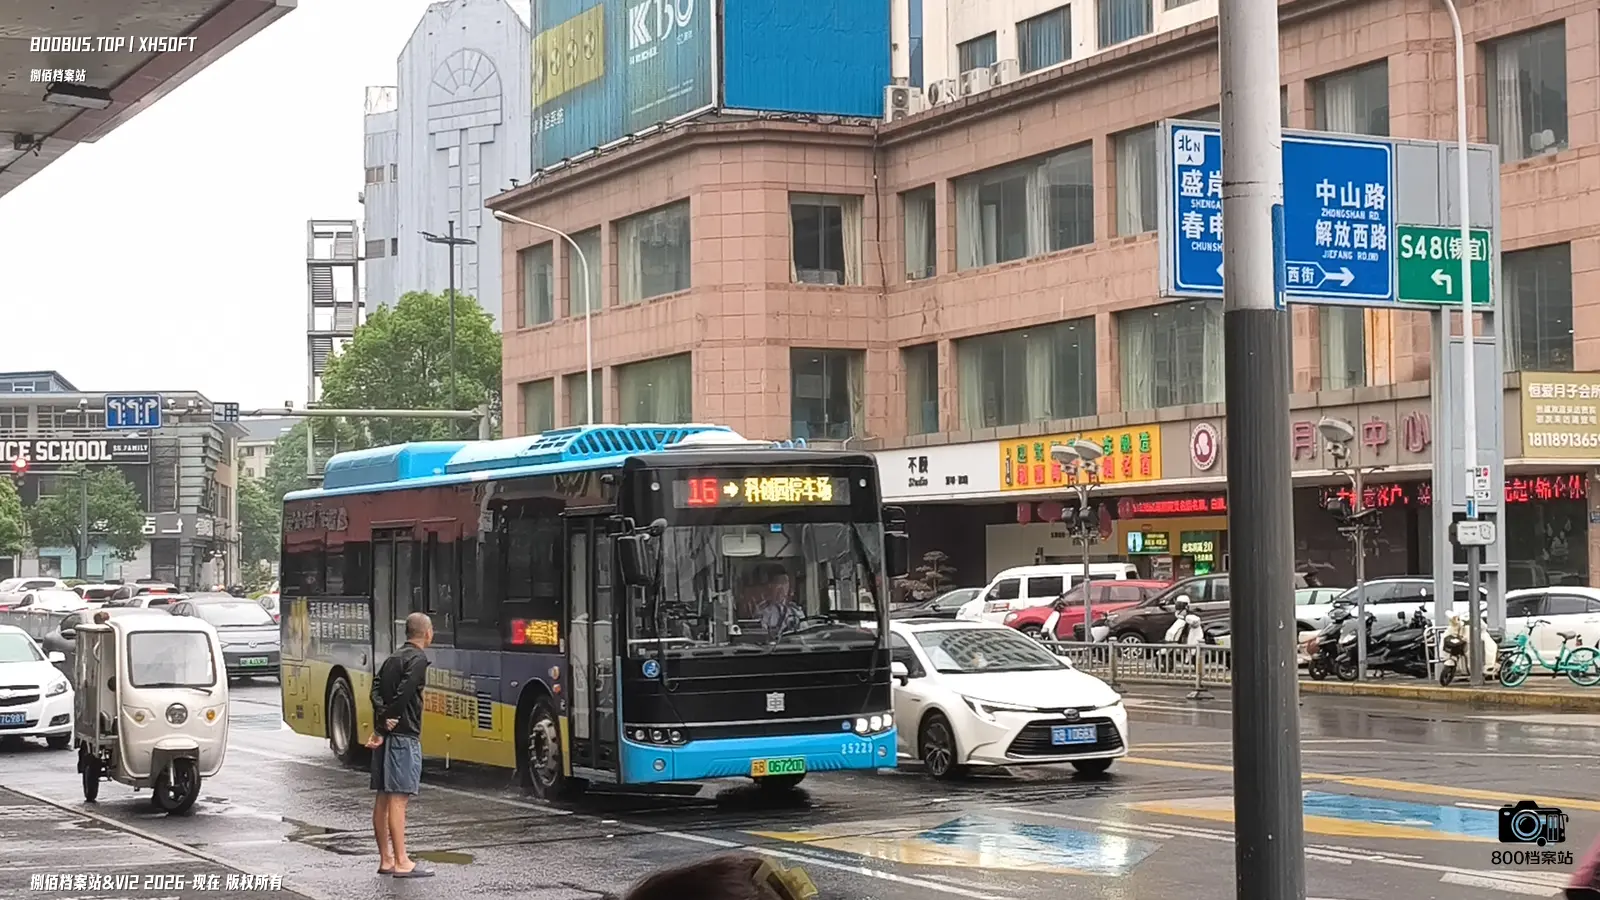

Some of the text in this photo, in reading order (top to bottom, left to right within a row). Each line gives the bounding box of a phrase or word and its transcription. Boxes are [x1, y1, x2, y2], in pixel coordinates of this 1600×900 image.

[1178, 134, 1201, 152] 北 N
[1316, 178, 1386, 210] 中山路
[1321, 208, 1366, 220] ZHONGSHAN
[1315, 218, 1387, 251] 解放西路
[1286, 266, 1315, 284] 西街
[1293, 411, 1431, 461] 月中心
[1528, 432, 1600, 447] 1811891365
[35, 441, 112, 461] SCHOOL
[688, 478, 719, 504] 16
[744, 477, 833, 502] 科创园停车场
